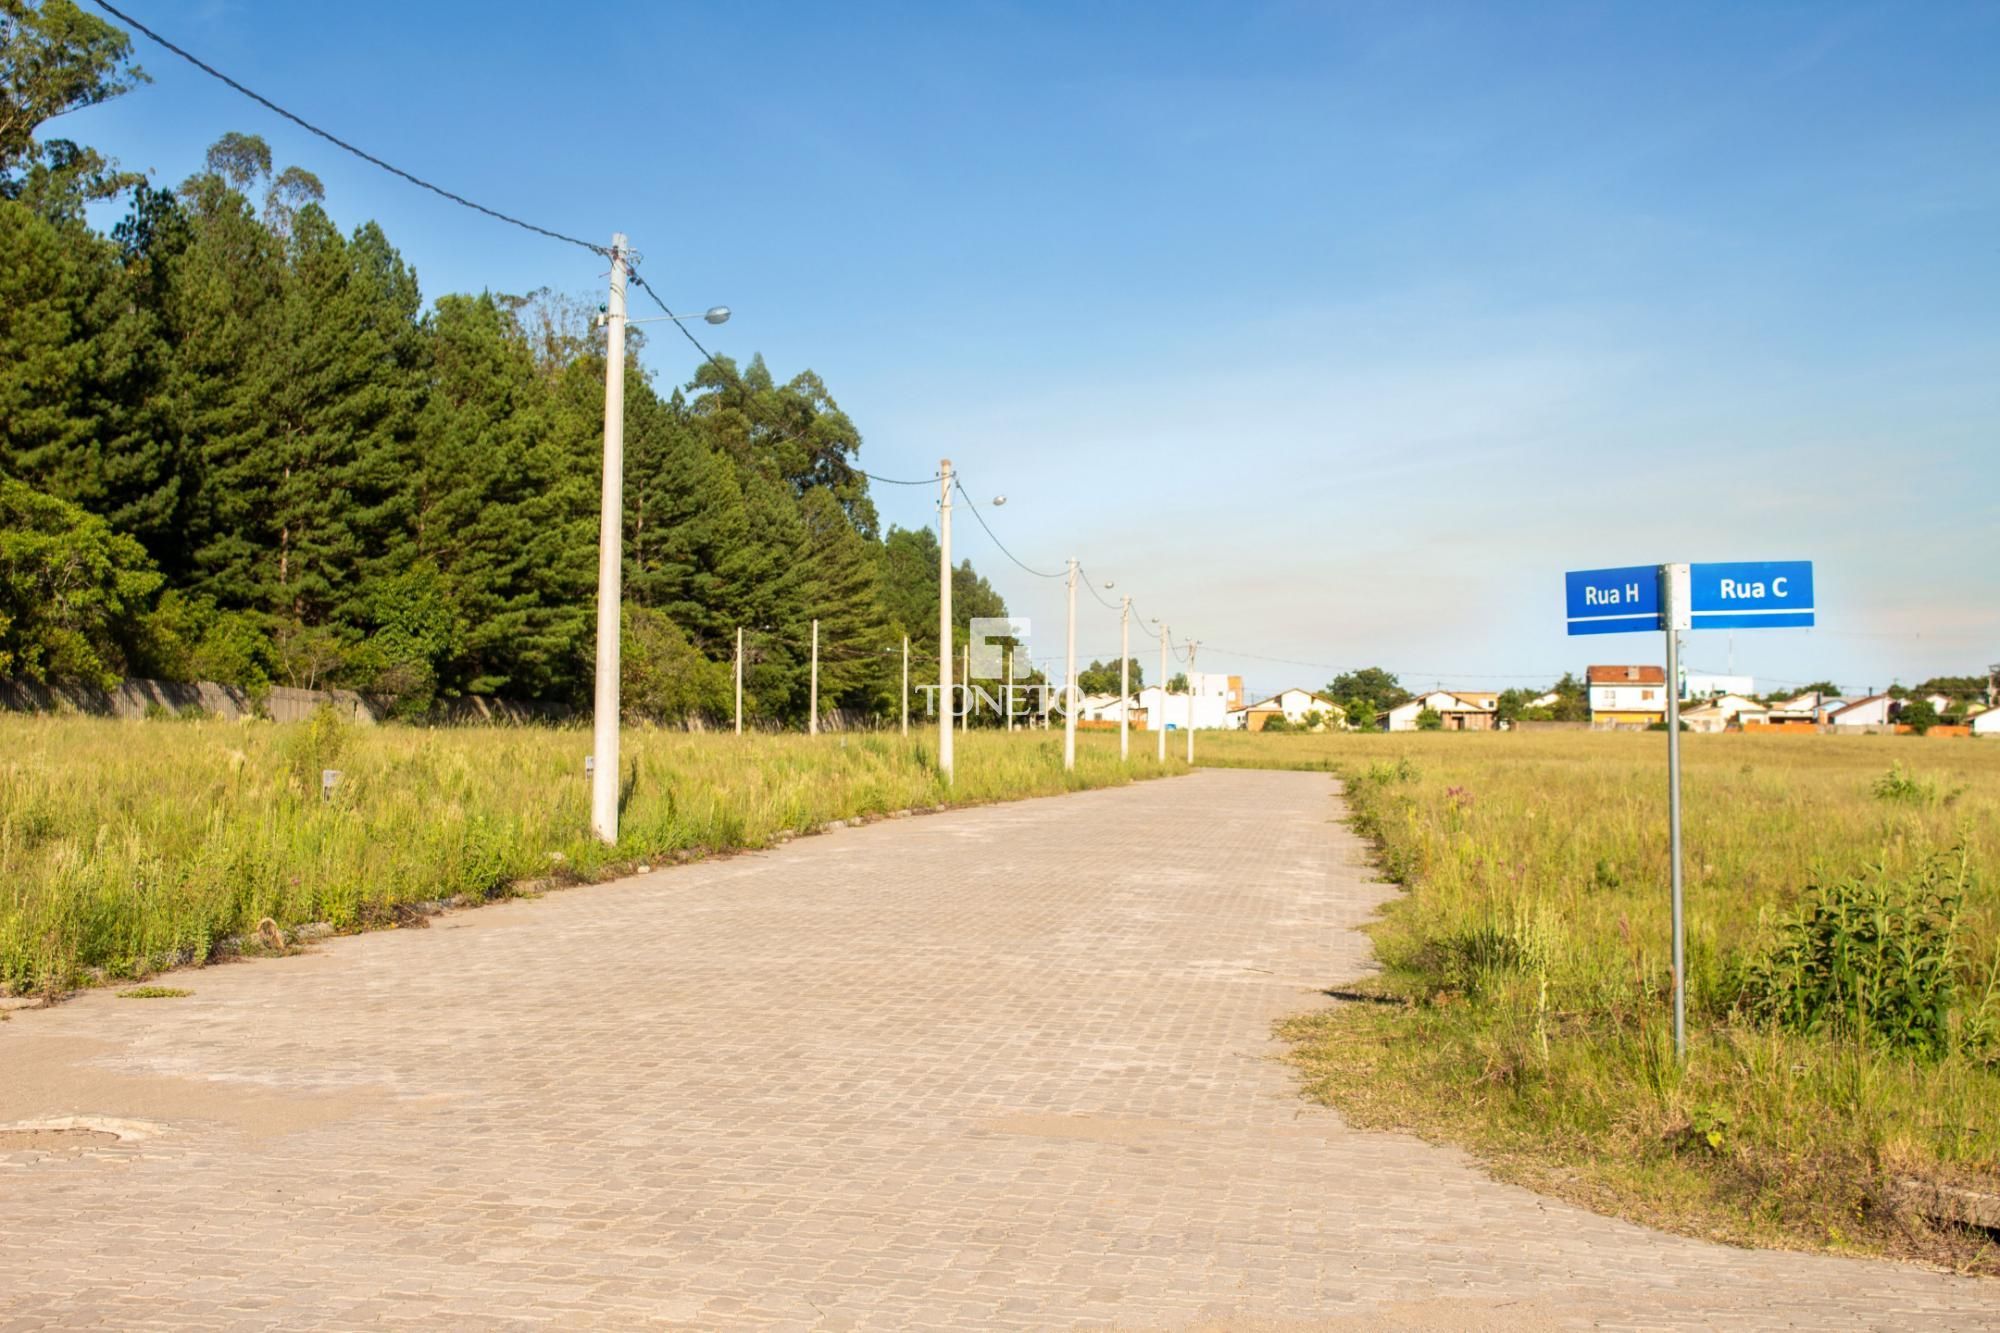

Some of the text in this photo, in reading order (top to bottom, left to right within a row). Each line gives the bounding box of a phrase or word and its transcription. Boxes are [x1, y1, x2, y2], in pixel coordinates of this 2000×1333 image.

[1585, 583, 1639, 605] Rua H
[1720, 577, 1788, 599] Rua C
